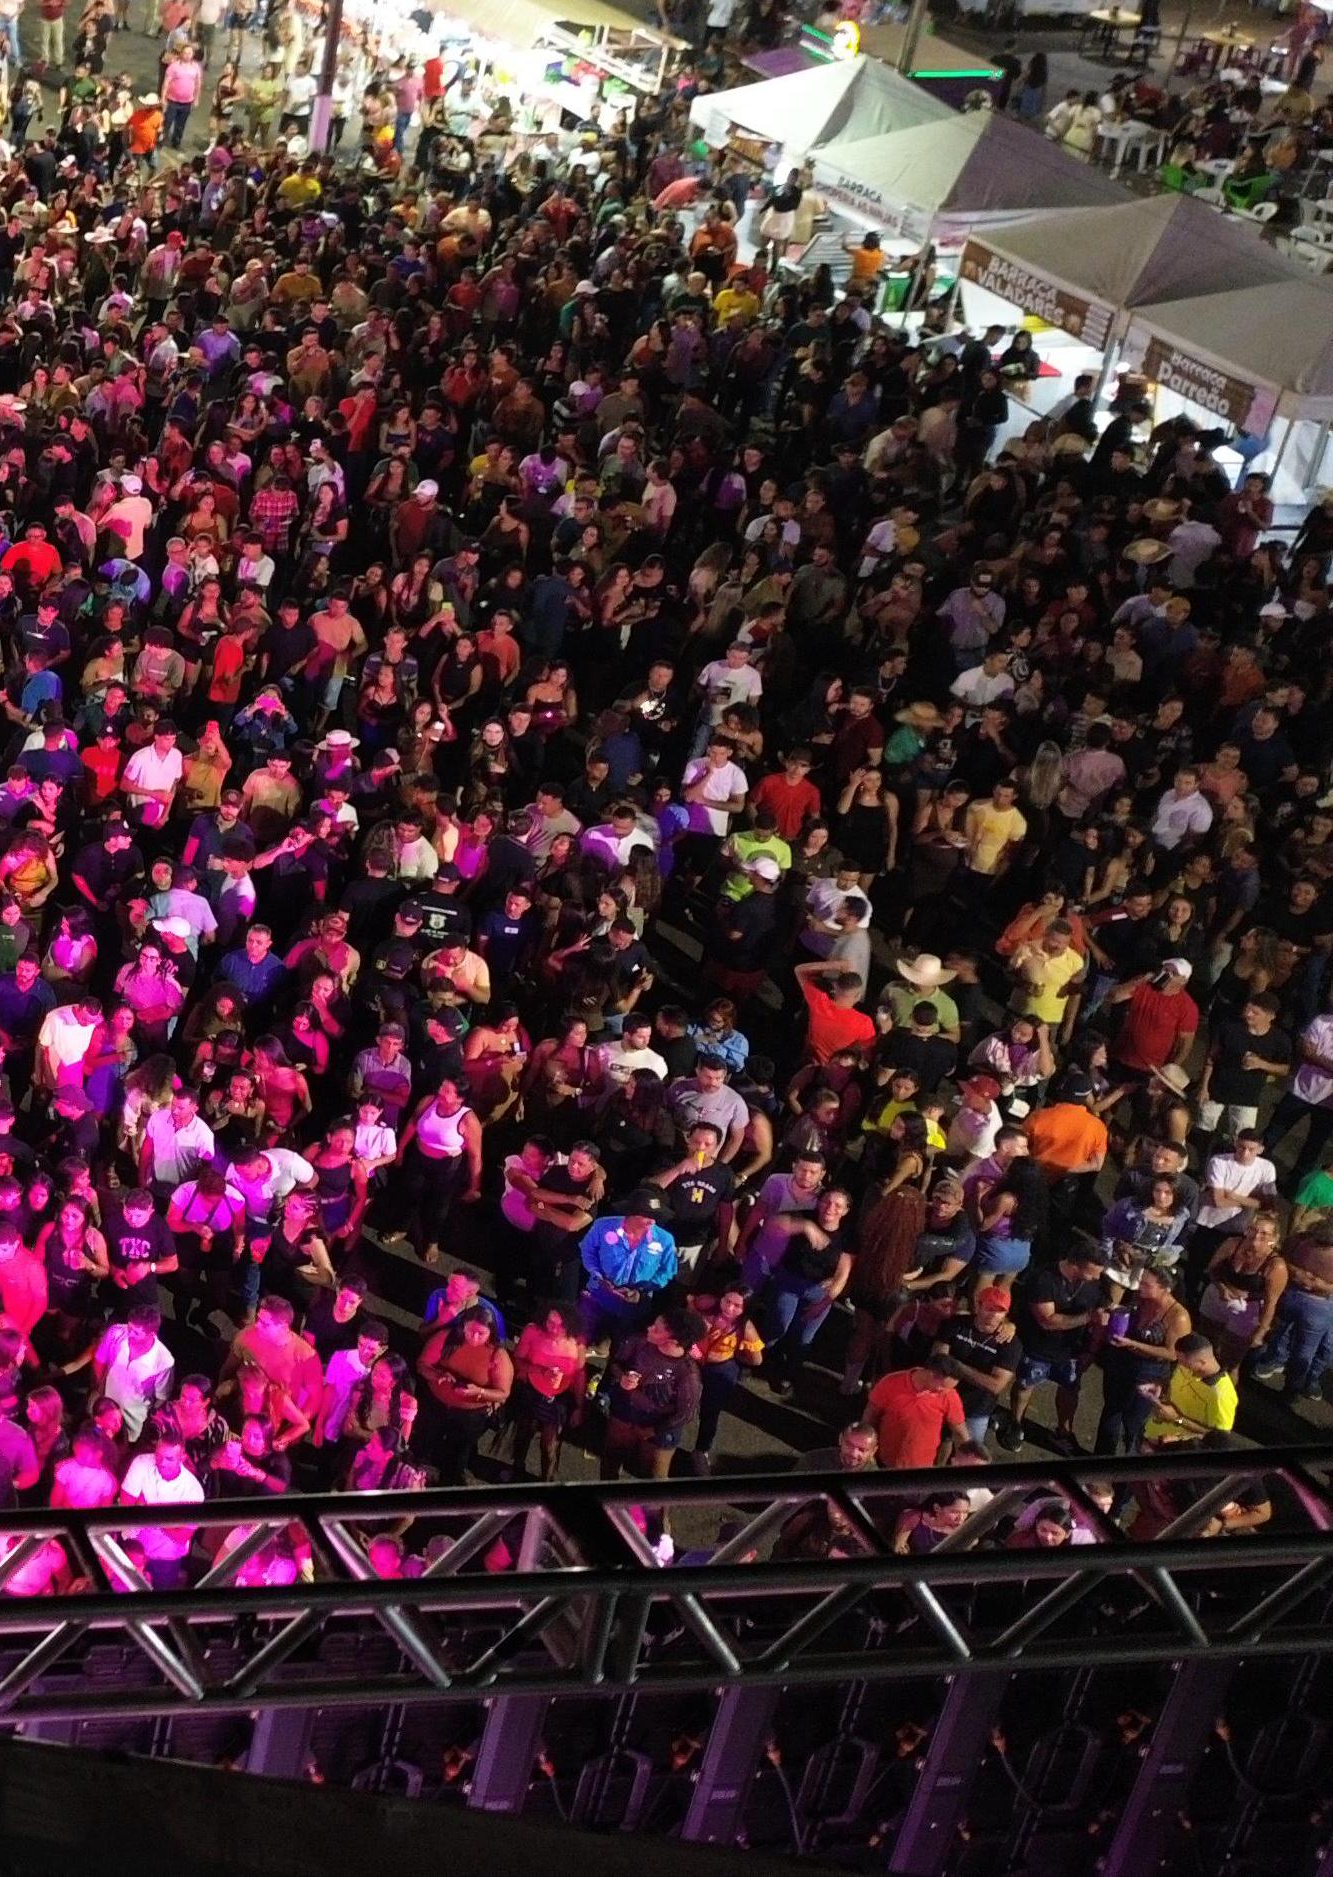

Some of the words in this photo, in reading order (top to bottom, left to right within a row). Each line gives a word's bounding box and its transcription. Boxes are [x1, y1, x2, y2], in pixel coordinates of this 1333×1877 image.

[836, 176, 882, 203] BARRACA
[977, 266, 1065, 327] VALADARES
[988, 255, 1057, 303] BARRACA
[119, 1237, 151, 1259] TXC
